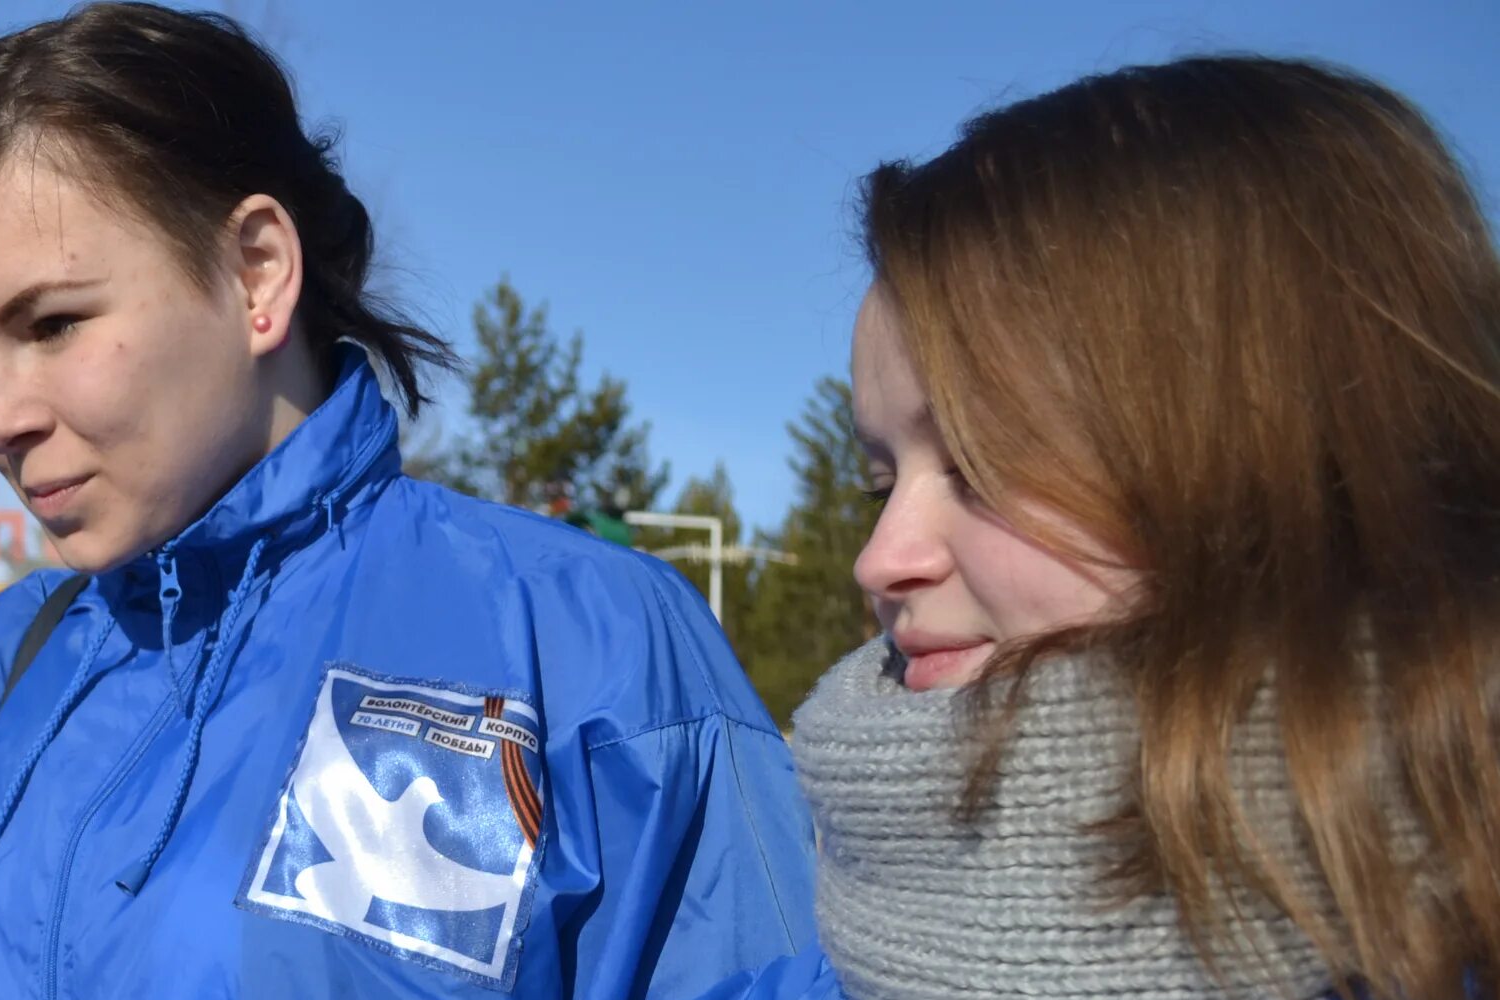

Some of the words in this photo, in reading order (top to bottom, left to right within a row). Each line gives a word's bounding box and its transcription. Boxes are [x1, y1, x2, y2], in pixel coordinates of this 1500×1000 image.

[366, 698, 469, 728] ВОЛОНТЁРСКИЙ
[485, 720, 537, 749] КОРПУС
[431, 730, 487, 756] ПОБЕДЫ
